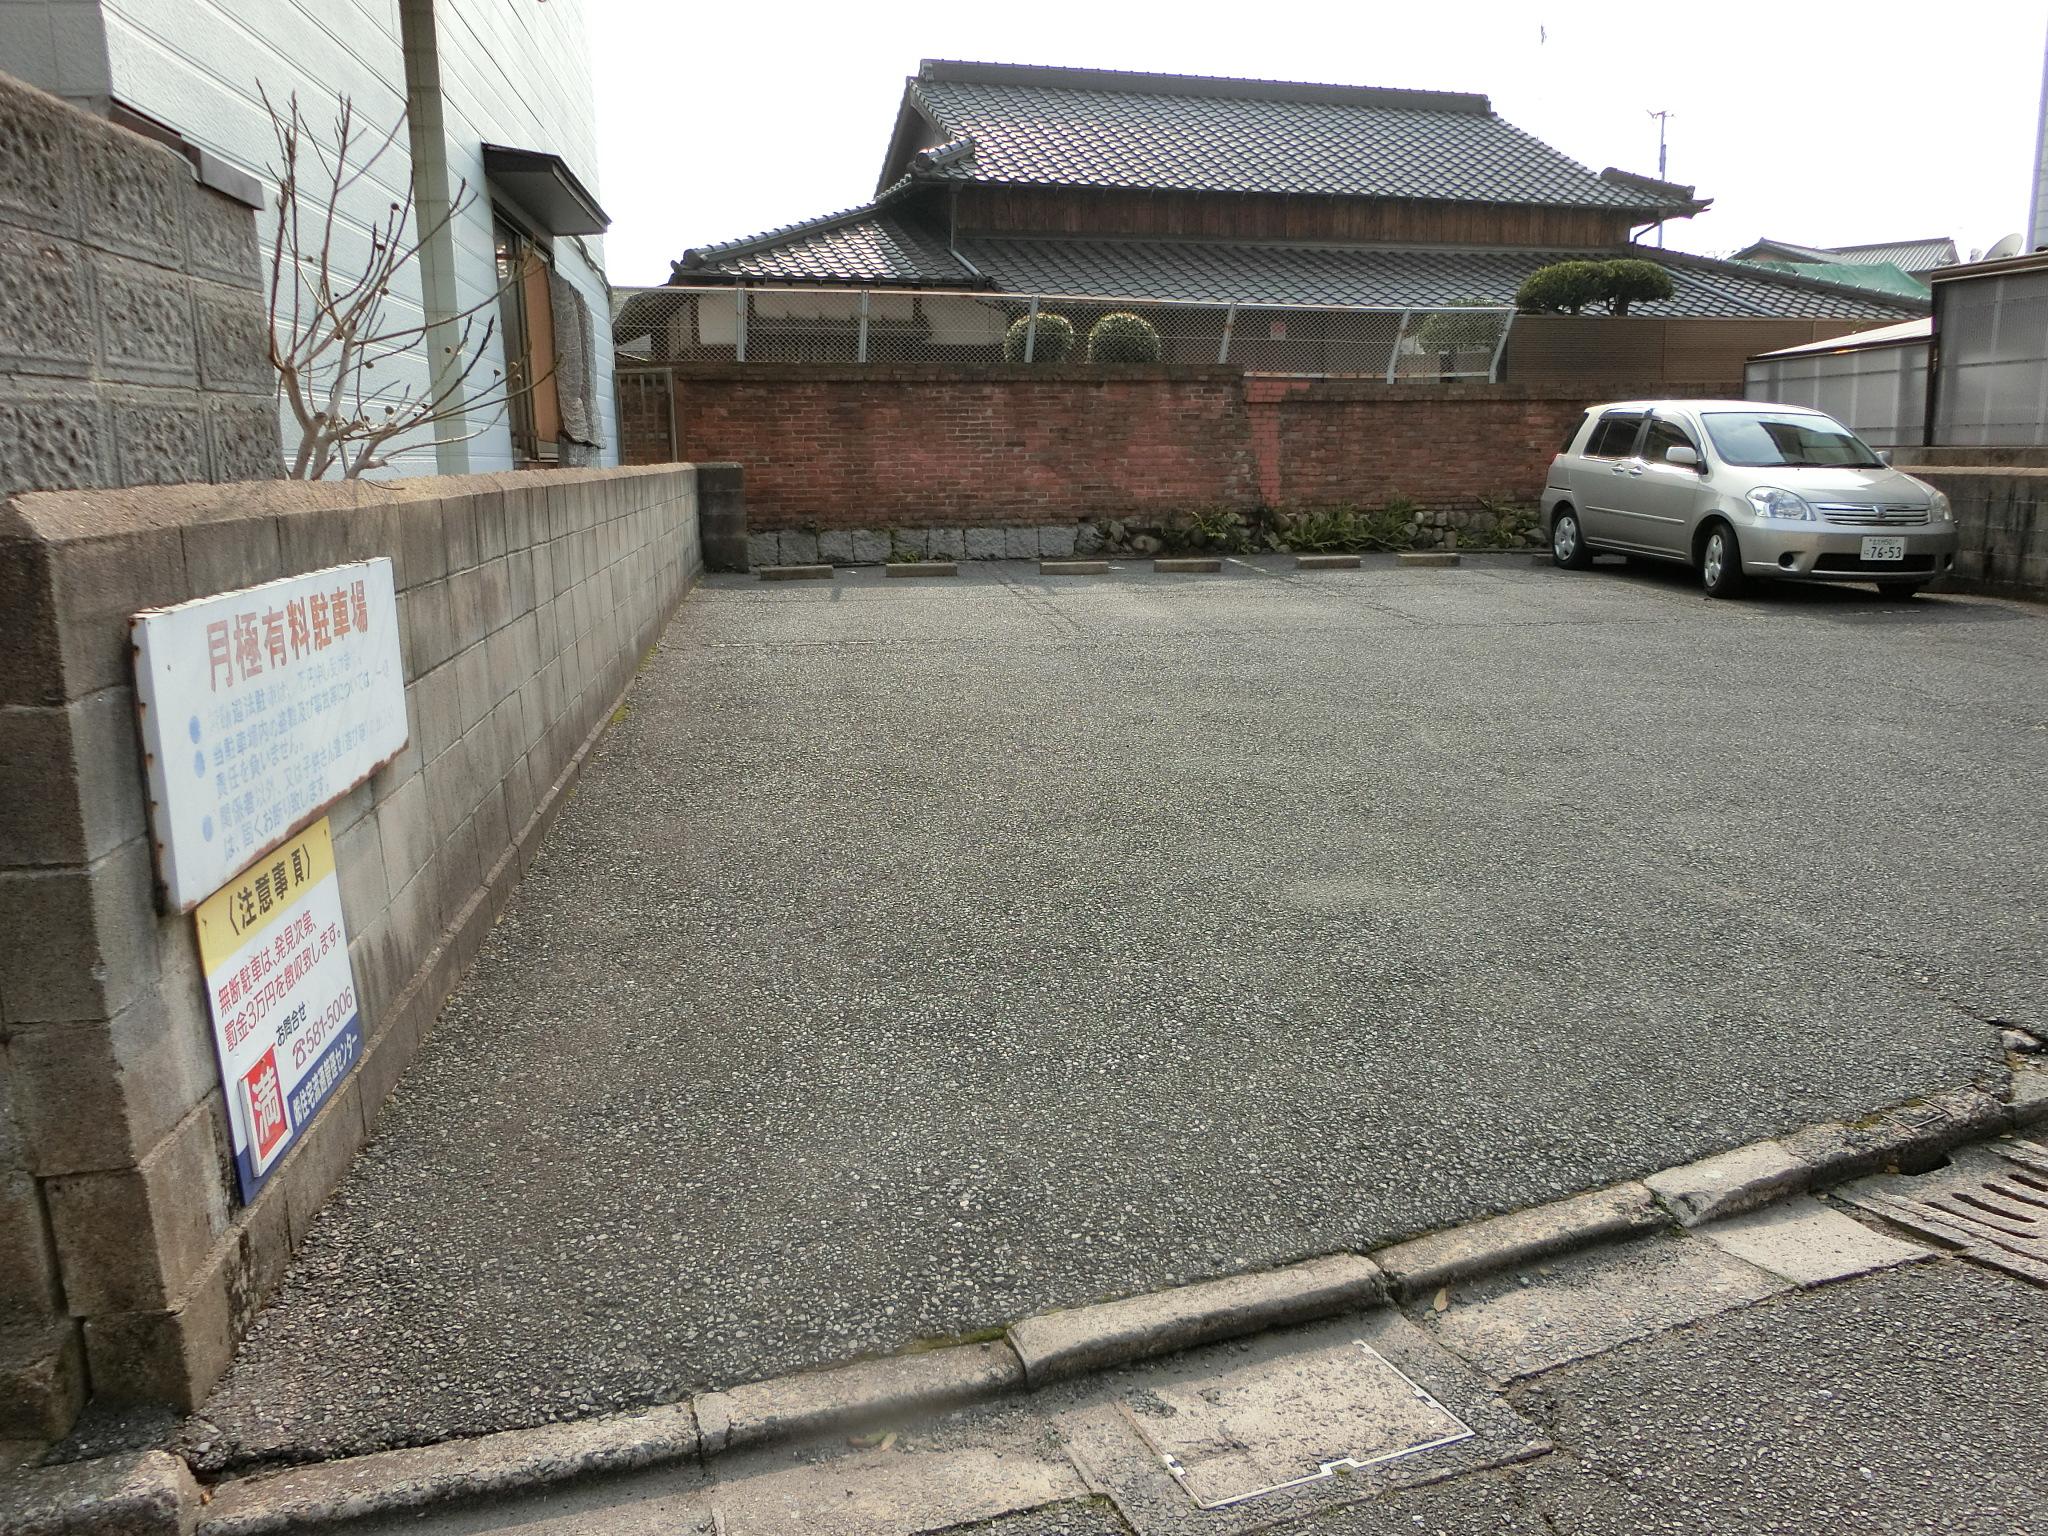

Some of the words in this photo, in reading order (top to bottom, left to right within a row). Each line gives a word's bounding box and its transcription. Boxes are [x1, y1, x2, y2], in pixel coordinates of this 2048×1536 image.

[1871, 546, 1902, 558] 76-53
[205, 579, 368, 693] 月極有料駐車場
[216, 904, 317, 1017] 無断駐車は、発見次第、
[222, 917, 342, 1054] 罰金3万円を徴収致します。
[274, 998, 307, 1049] お問合せ
[304, 982, 353, 1056] 581-5006
[251, 1064, 282, 1142] 満
